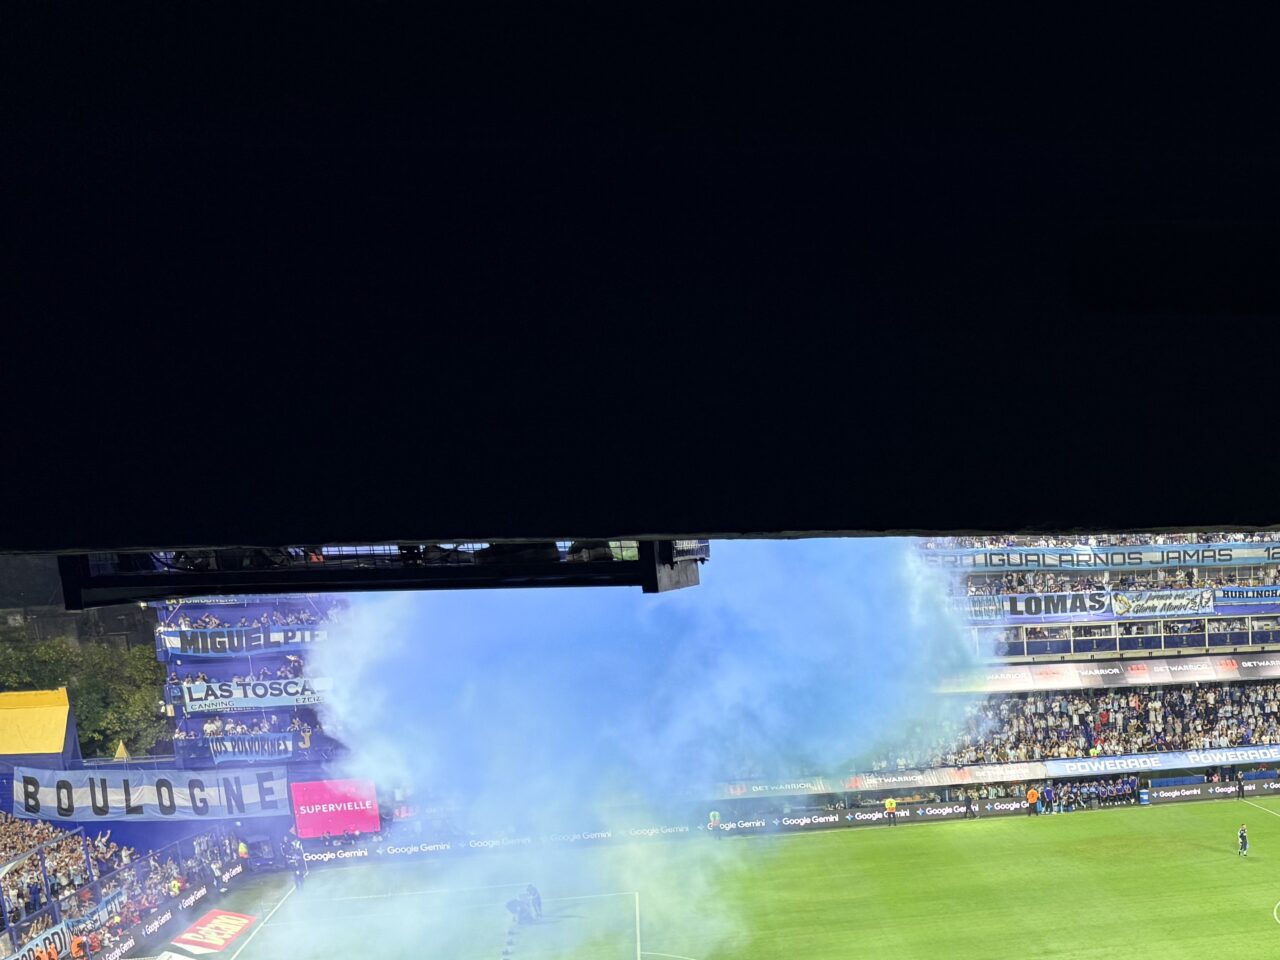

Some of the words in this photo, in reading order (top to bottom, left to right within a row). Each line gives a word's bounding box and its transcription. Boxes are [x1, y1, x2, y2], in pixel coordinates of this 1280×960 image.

[1150, 545, 1233, 565] JAMÁS
[1009, 593, 1106, 616] LOMAS
[179, 625, 281, 653] MIGUEL
[186, 683, 234, 702] LAS
[236, 680, 317, 699] TOSCA
[191, 701, 235, 711] CANNING
[1187, 749, 1280, 763] POWERADE
[1065, 757, 1161, 774] POWERADE
[22, 771, 279, 817] BOULOGNE
[1159, 789, 1180, 798] Google
[1181, 787, 1201, 796] Gemini
[1215, 785, 1235, 794] Google
[299, 801, 373, 815] SUPERVIELLE
[925, 806, 952, 816] Google
[994, 801, 1021, 811] Google
[782, 815, 811, 826] Google
[812, 813, 839, 824] Gemini
[855, 811, 883, 821] Google
[737, 818, 765, 829] Gemini
[303, 851, 336, 862] Google
[337, 848, 369, 859] Gemini
[387, 844, 419, 855] Google
[420, 842, 450, 853] Gemini
[181, 914, 250, 946] Betano
[120, 937, 135, 955] Gemini
